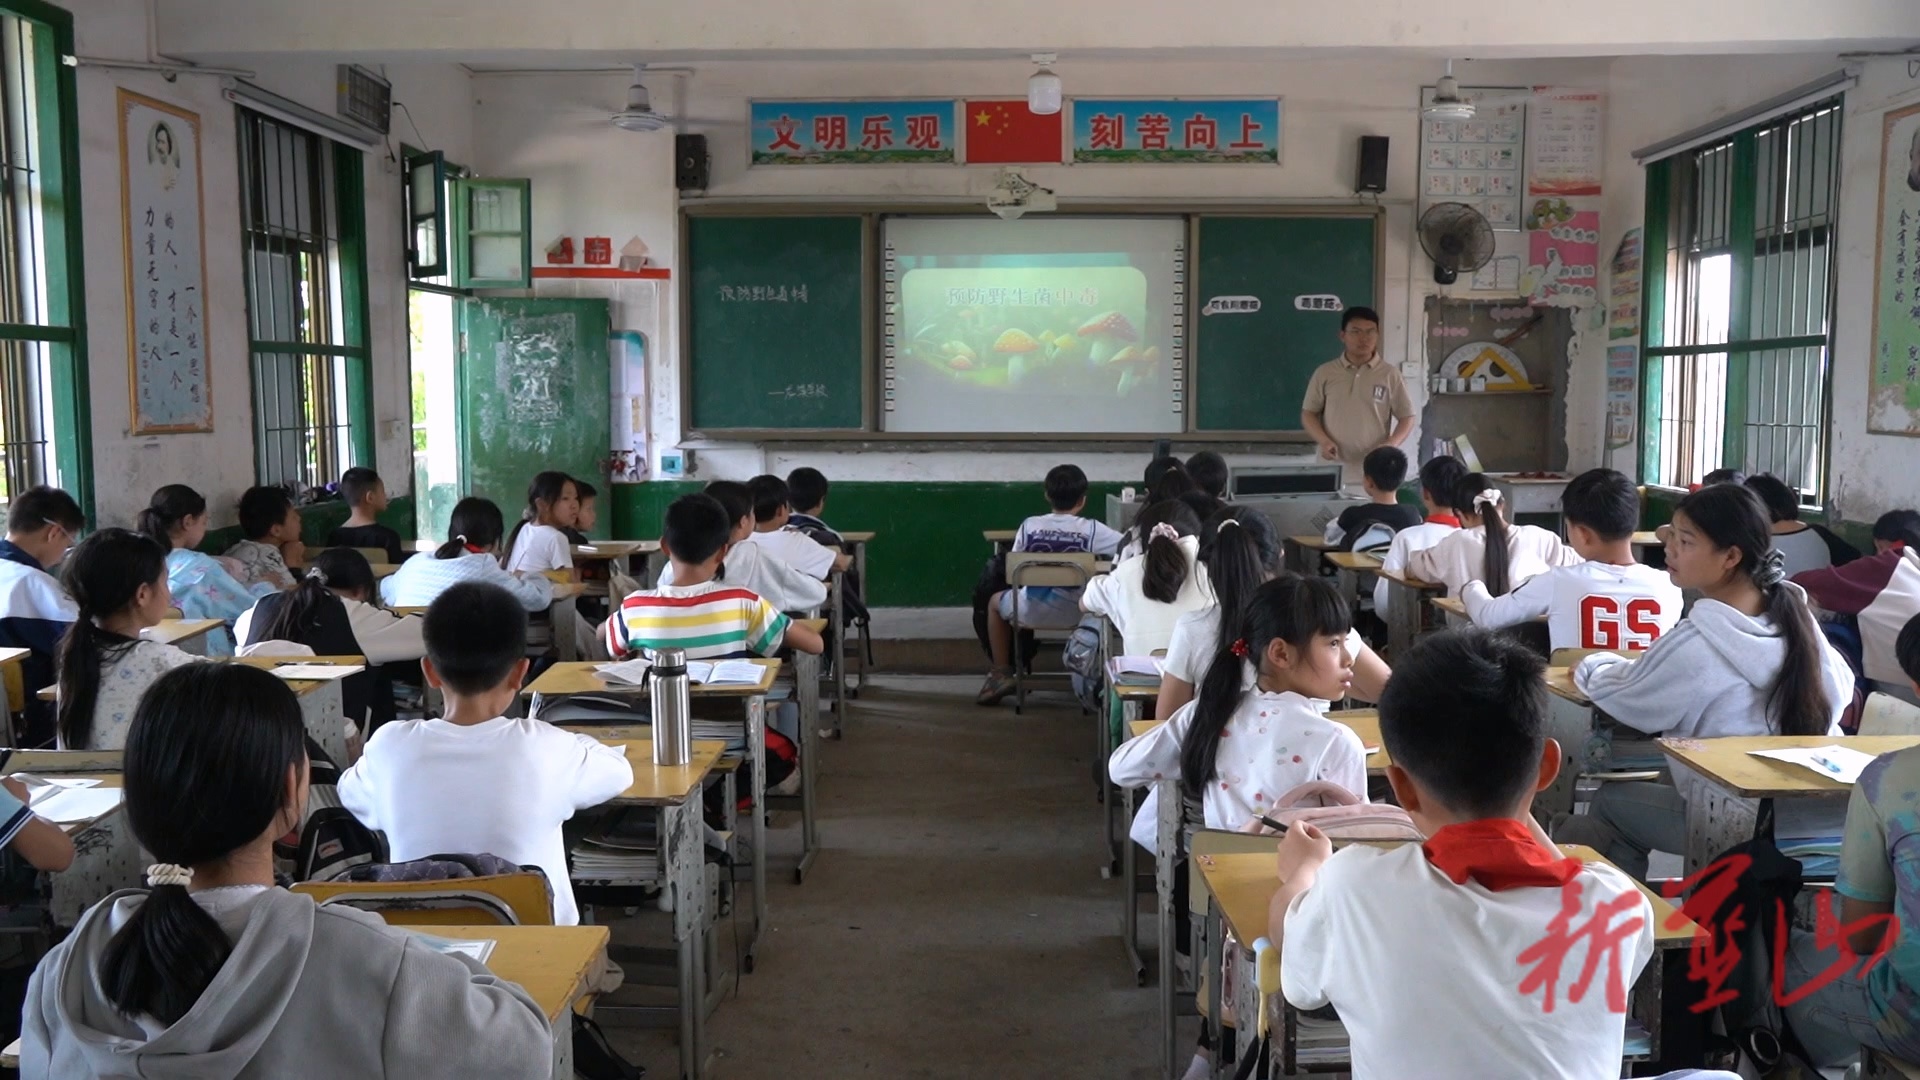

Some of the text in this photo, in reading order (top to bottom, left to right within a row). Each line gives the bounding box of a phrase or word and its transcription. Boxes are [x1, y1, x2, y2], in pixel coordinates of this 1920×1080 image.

[767, 115, 942, 151] 文明乐观
[1088, 113, 1264, 150] 刻苦向上
[946, 286, 1100, 306] 预防野生菌中毒
[1580, 594, 1662, 650] GS
